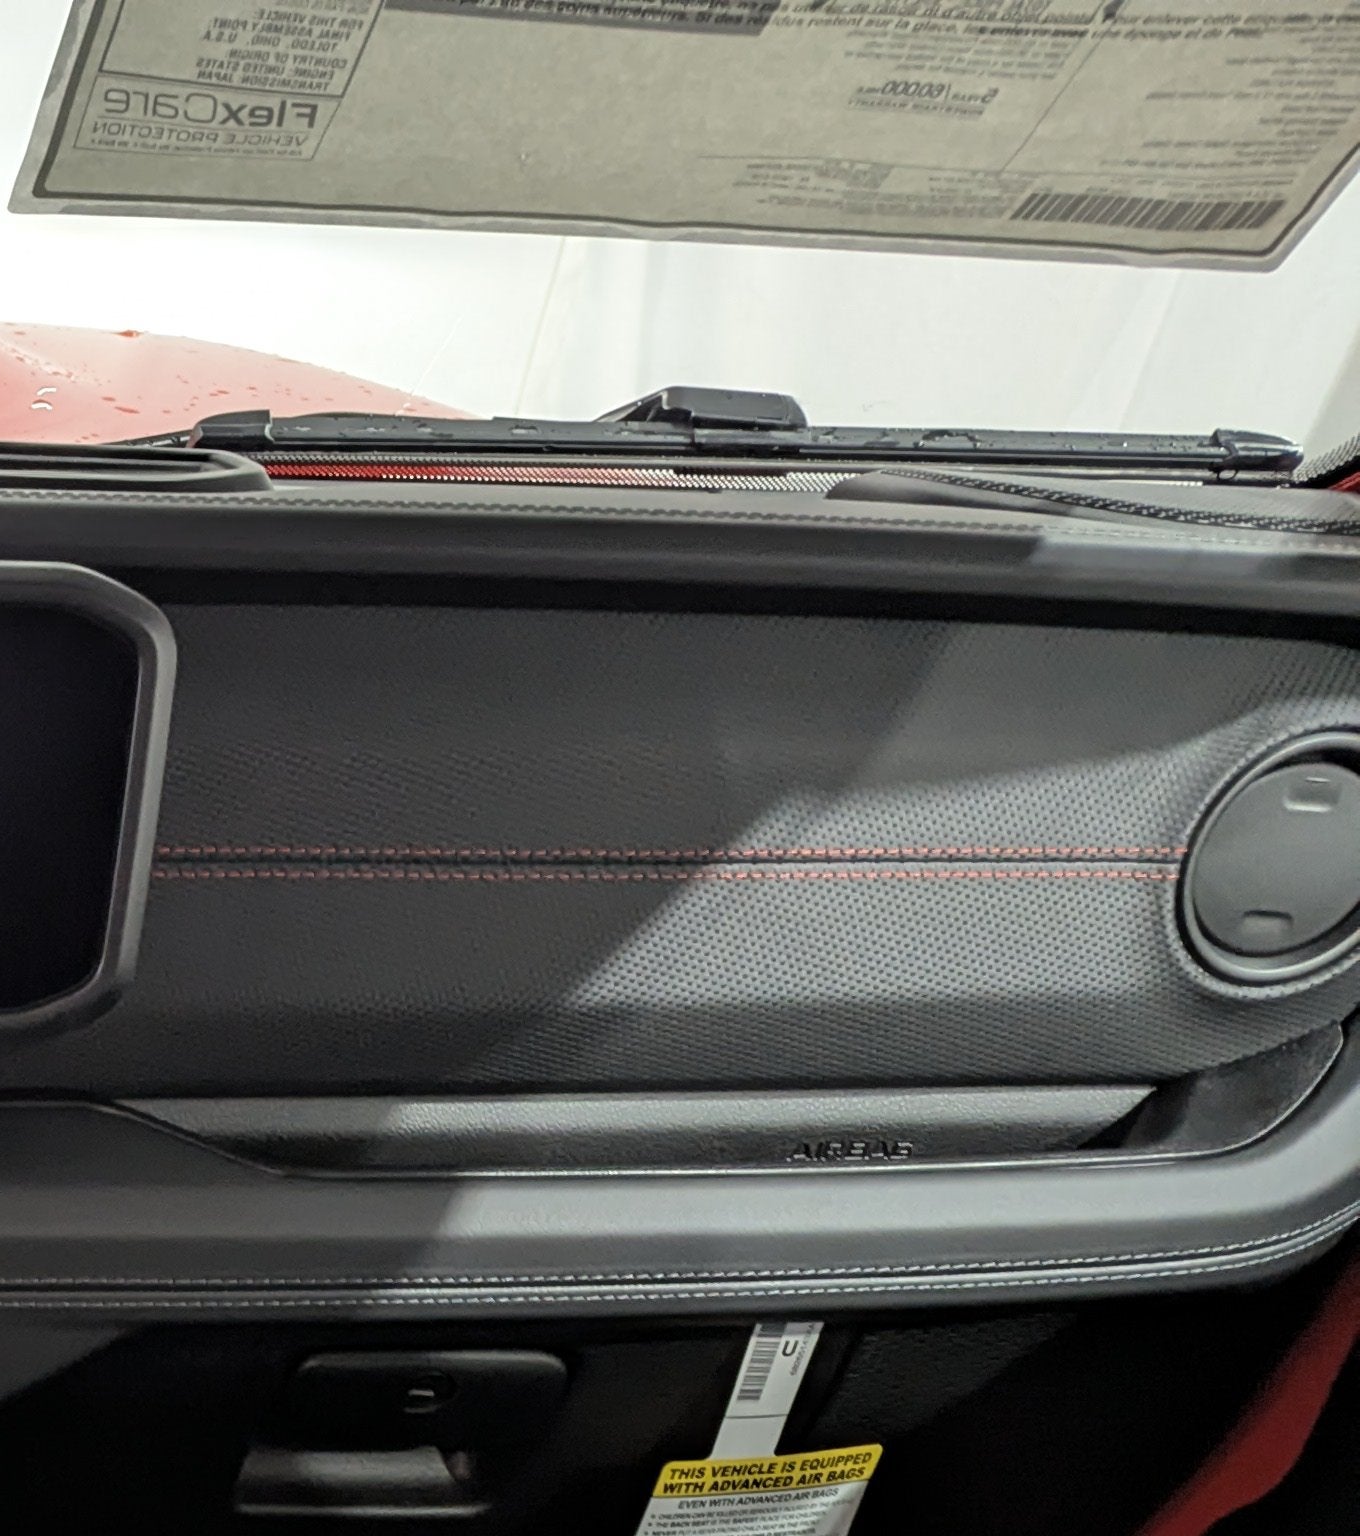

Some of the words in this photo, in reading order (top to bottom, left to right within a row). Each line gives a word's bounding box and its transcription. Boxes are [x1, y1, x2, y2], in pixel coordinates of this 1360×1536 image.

[781, 1340, 800, 1357] U
[669, 1466, 707, 1480] THIS
[710, 1461, 776, 1478] VEHICLE
[780, 1460, 796, 1474] IS
[799, 1451, 873, 1472] EQUIPPED
[662, 1481, 705, 1495] WITH
[708, 1475, 794, 1493] ADVANCED
[796, 1471, 823, 1485] AIR
[826, 1466, 866, 1482] BAGS
[678, 1499, 707, 1509] EVEN
[709, 1497, 736, 1508] WITH
[737, 1493, 794, 1505] ADVANCED
[794, 1490, 811, 1501] AIR
[811, 1487, 840, 1499] BAGS
